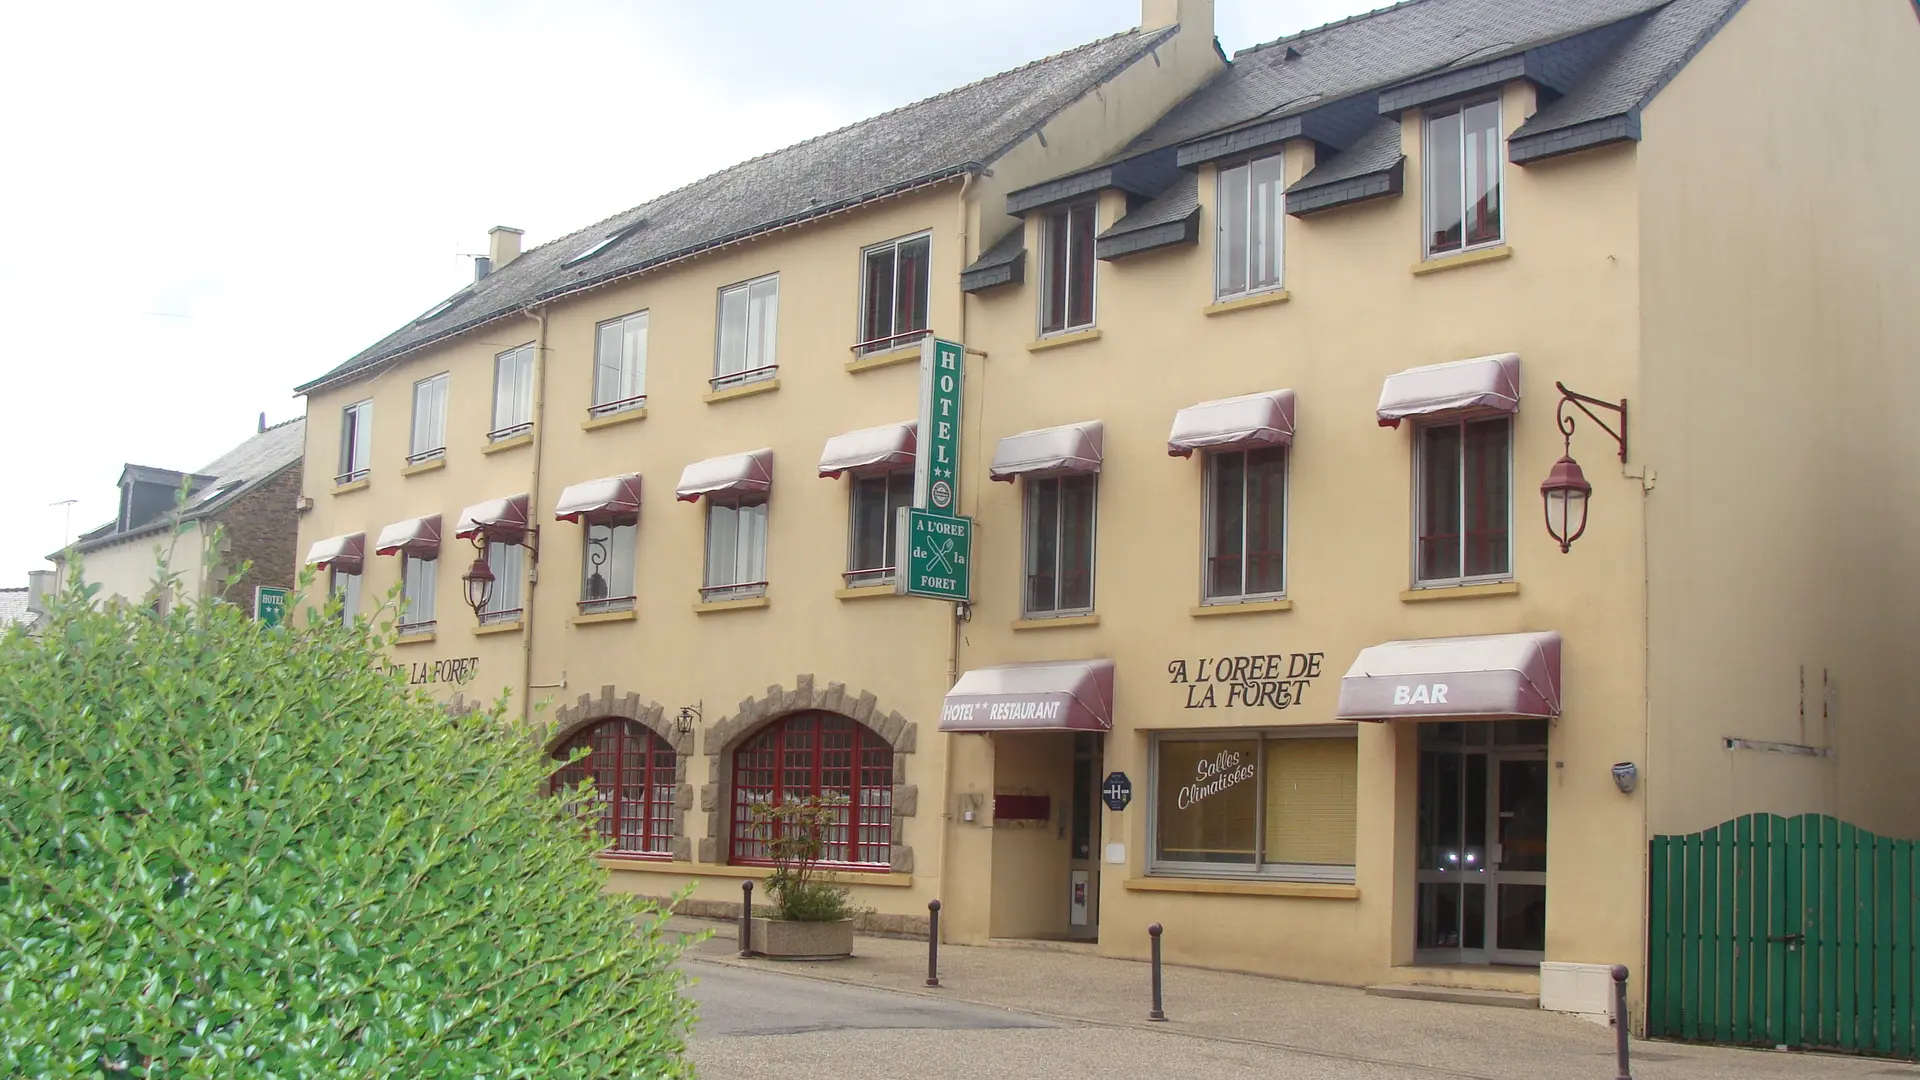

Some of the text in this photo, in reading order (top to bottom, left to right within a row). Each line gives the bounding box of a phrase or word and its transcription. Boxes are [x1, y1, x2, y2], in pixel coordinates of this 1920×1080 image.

[938, 351, 956, 464] HOTEL
[916, 519, 965, 537] A L'OREE
[913, 546, 965, 564] de la
[921, 575, 956, 590] FORET
[262, 594, 285, 604] HOTEL
[411, 662, 427, 685] LA
[432, 657, 479, 685] FORET
[1168, 652, 1325, 688] A L'OREE DE
[1184, 680, 1311, 709] LA FORET
[1393, 684, 1448, 705] BAR
[943, 701, 1061, 720] HOTEL RESTAURANT
[1196, 750, 1240, 781] Salles
[1111, 784, 1121, 799] H
[1178, 764, 1254, 810] Climatisées
